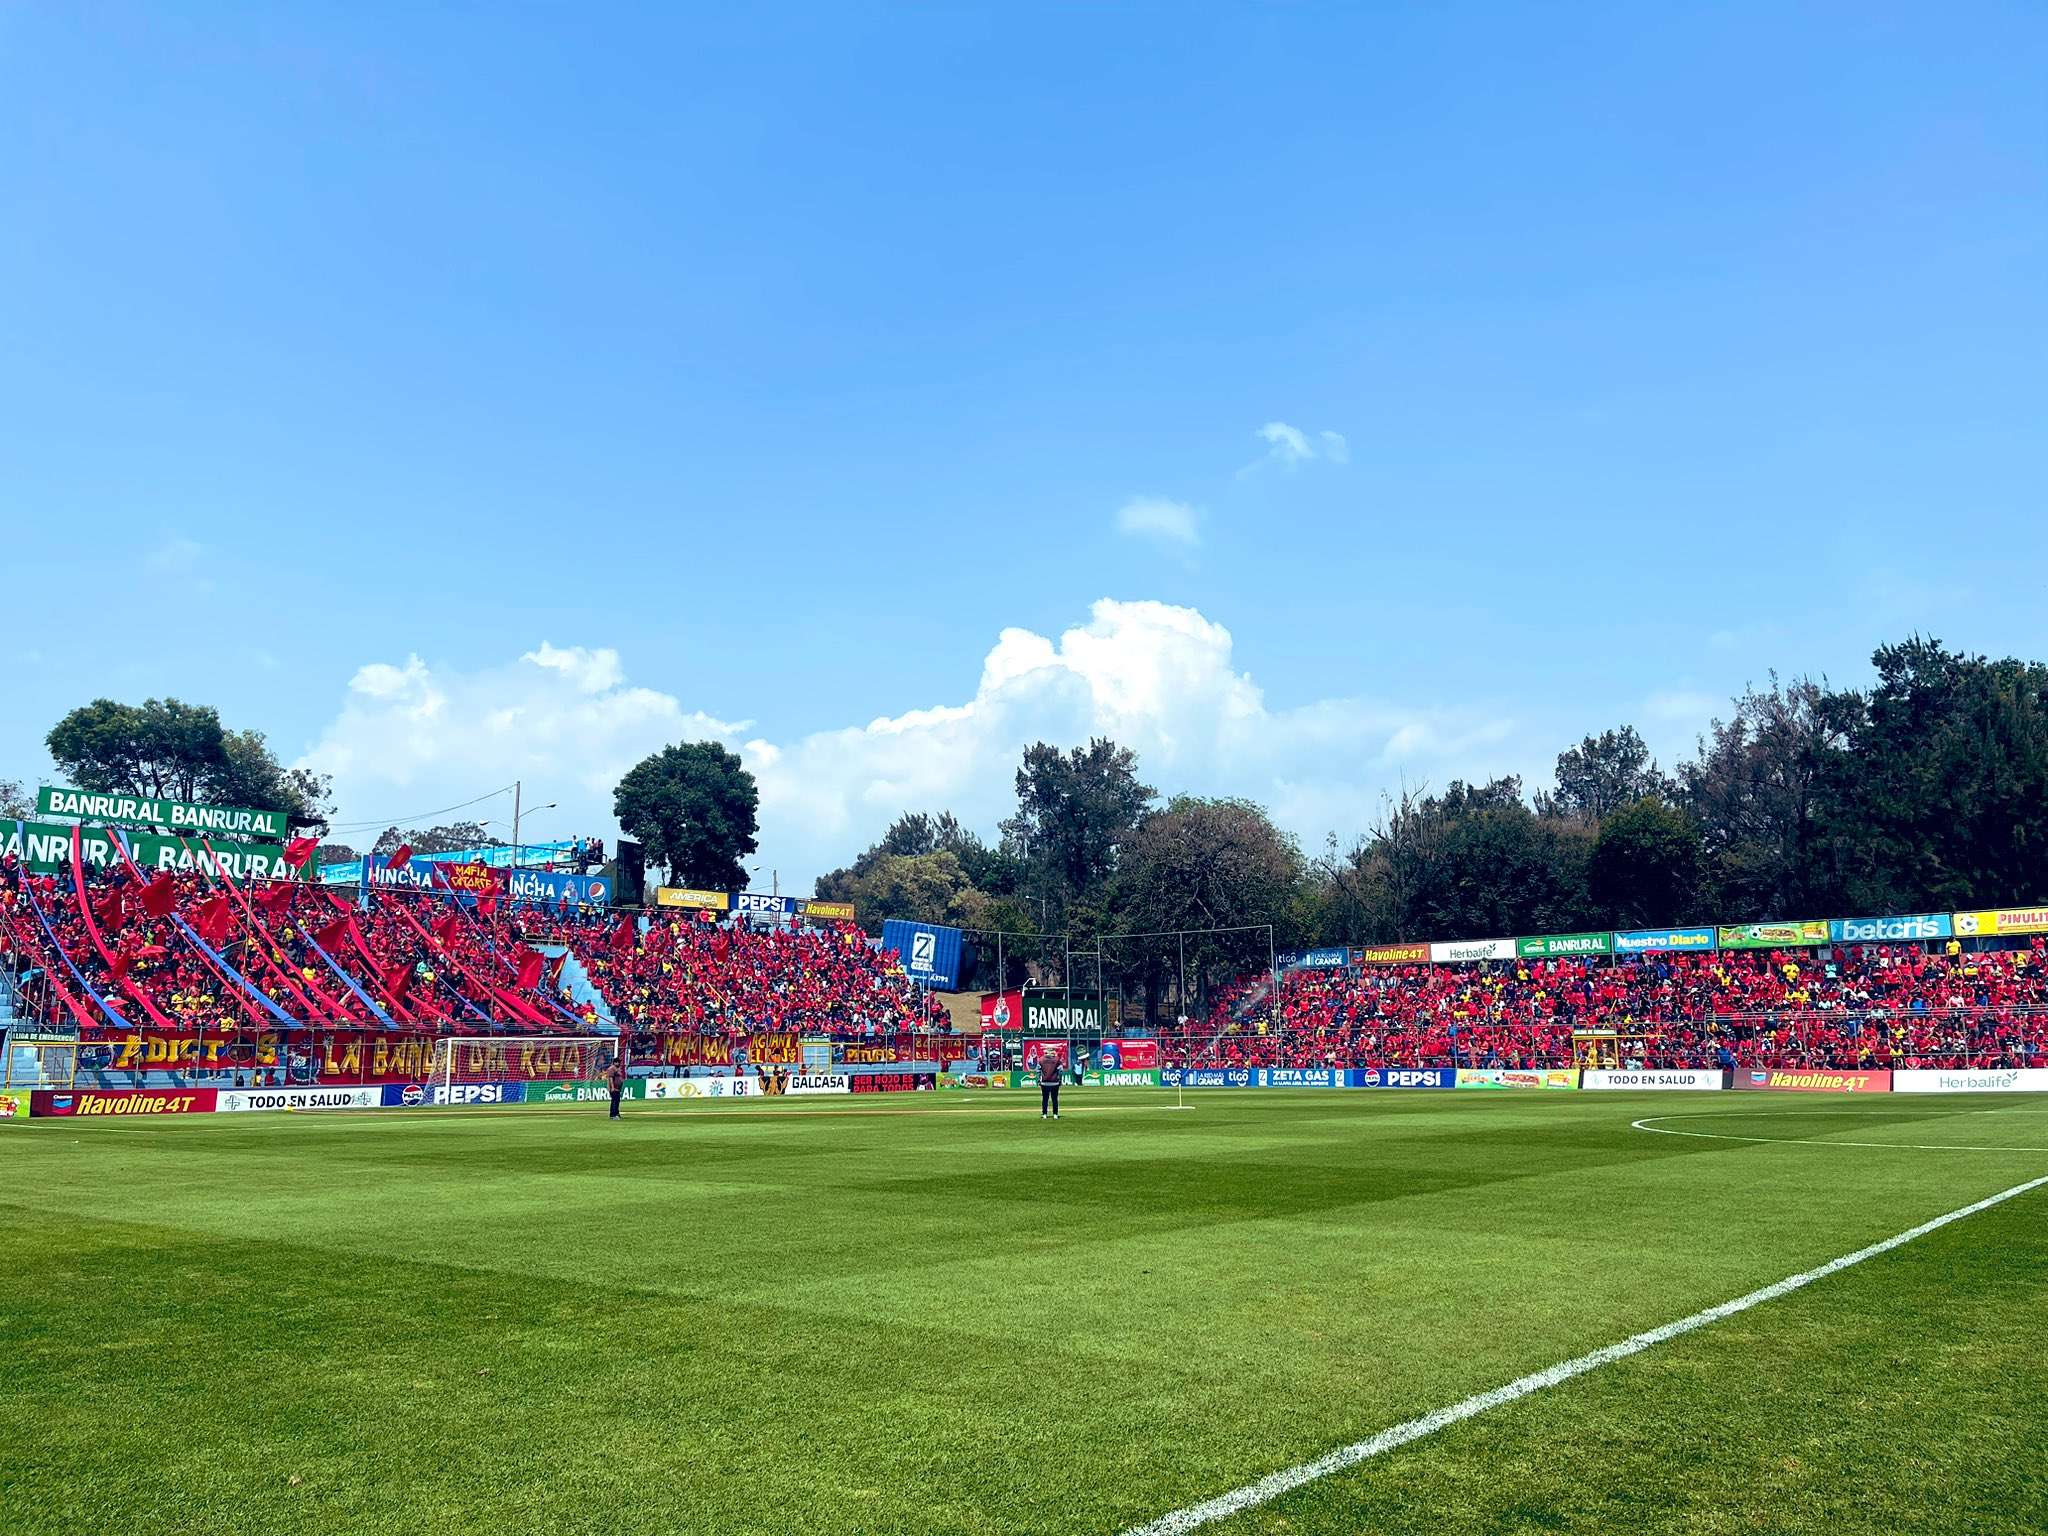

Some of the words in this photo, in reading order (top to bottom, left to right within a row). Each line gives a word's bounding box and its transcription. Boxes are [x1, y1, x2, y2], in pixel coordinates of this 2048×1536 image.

[50, 791, 163, 823] BANRURAL
[171, 805, 276, 835] BANRURAL
[368, 862, 433, 888] HINCHA
[455, 866, 487, 877] MAFIA
[738, 895, 787, 912] PEPSI
[1843, 918, 1939, 940] betcris
[1550, 938, 1606, 952] BANRURAL
[1616, 935, 1667, 947] Nuestro
[1669, 934, 1709, 946] Diario
[1449, 946, 1493, 959] Herbalife
[1028, 1006, 1101, 1030] BANRURAL
[792, 1076, 844, 1089] GALCASA
[854, 1076, 872, 1085] SER
[875, 1075, 900, 1084] ROJO
[903, 1074, 914, 1083] ES
[1104, 1073, 1154, 1087] BANRURAL
[1273, 1070, 1302, 1081] ZETA
[1305, 1070, 1329, 1081] GAS
[1387, 1071, 1441, 1086] PEPSI
[1608, 1075, 1638, 1085] TODO
[1642, 1075, 1656, 1085] EN
[1659, 1075, 1695, 1085] SALUD
[1940, 1076, 2012, 1088] Herbalife
[248, 1095, 286, 1109] TODO
[310, 1093, 351, 1107] SALUD
[434, 1084, 502, 1104] PEPSI
